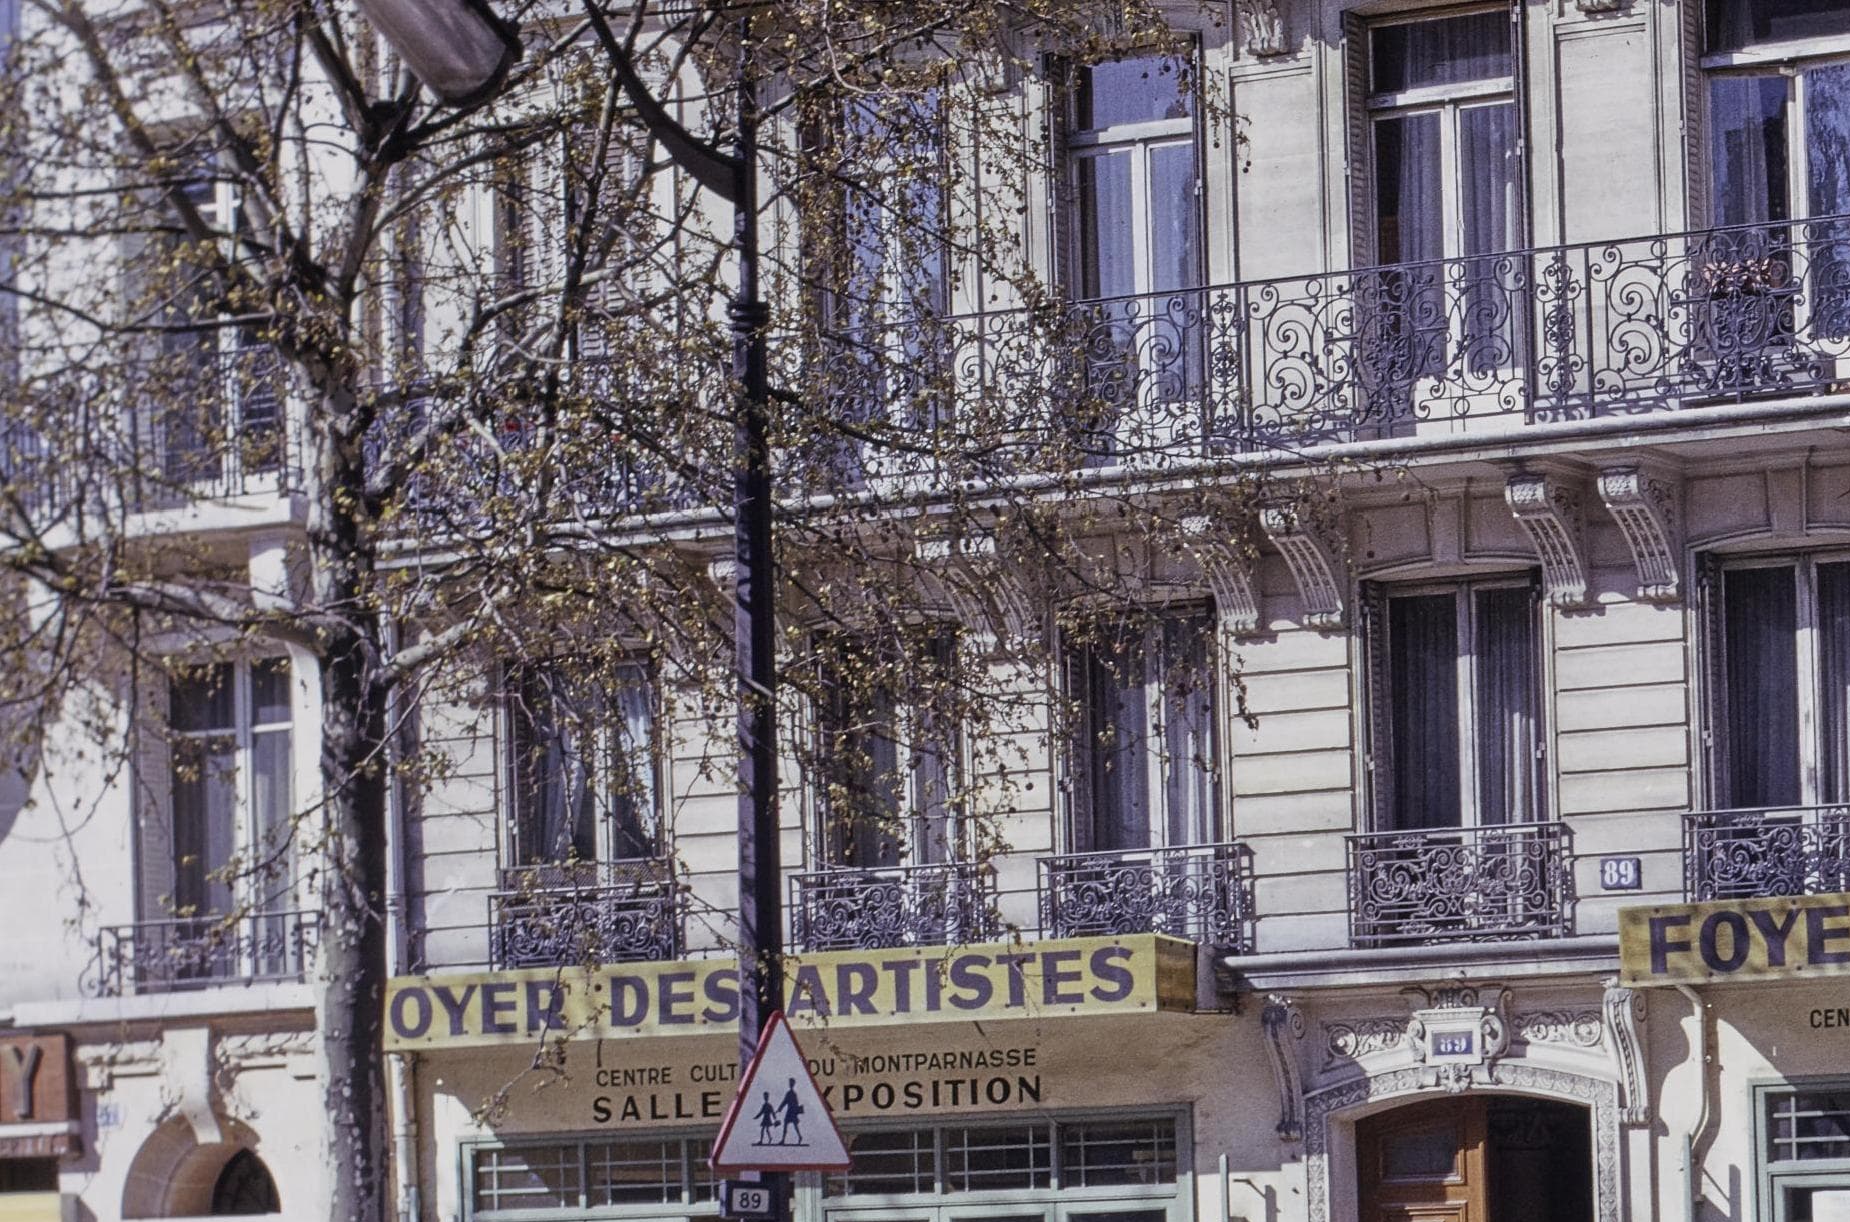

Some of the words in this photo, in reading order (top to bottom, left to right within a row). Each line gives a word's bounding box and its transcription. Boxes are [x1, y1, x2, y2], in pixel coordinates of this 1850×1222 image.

[1604, 861, 1633, 885] 89
[390, 981, 567, 1039] OYER
[611, 969, 740, 1027] DES
[787, 946, 1135, 1018] ARTISTES
[596, 1067, 671, 1087] CENTRE
[809, 1058, 835, 1076] DU
[855, 1048, 1037, 1074] MONTPARNASSE
[593, 1091, 722, 1123] SALLE
[738, 1192, 761, 1209] 89
